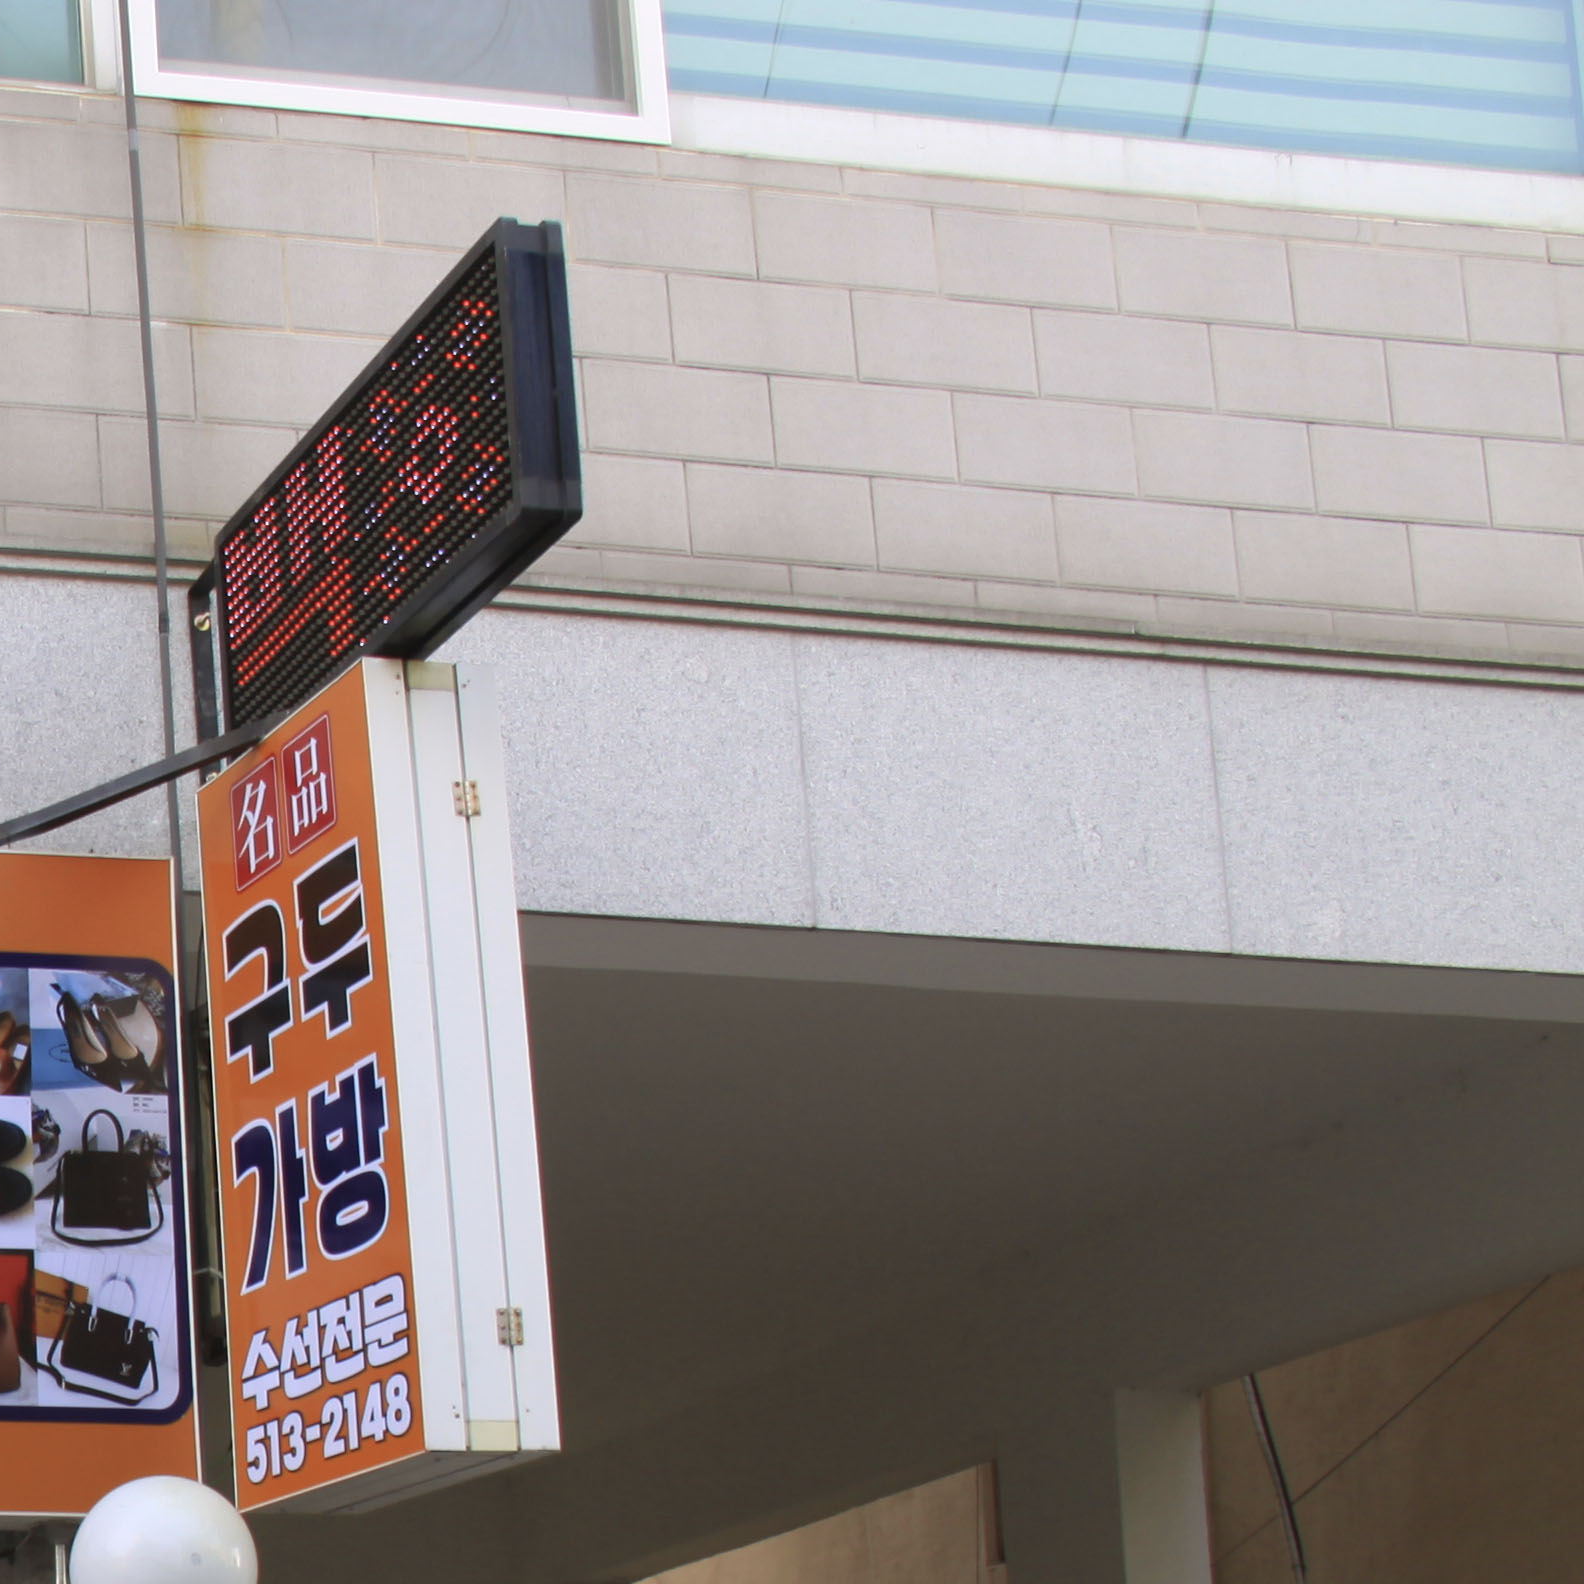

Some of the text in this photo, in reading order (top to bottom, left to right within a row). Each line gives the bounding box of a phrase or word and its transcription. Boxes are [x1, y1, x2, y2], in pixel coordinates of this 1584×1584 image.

[237, 735, 330, 880] 名品
[223, 837, 373, 1083] 구두
[231, 1051, 390, 1297] 가방
[240, 1271, 412, 1413] 수선전문
[244, 1372, 414, 1486] 513-2148
